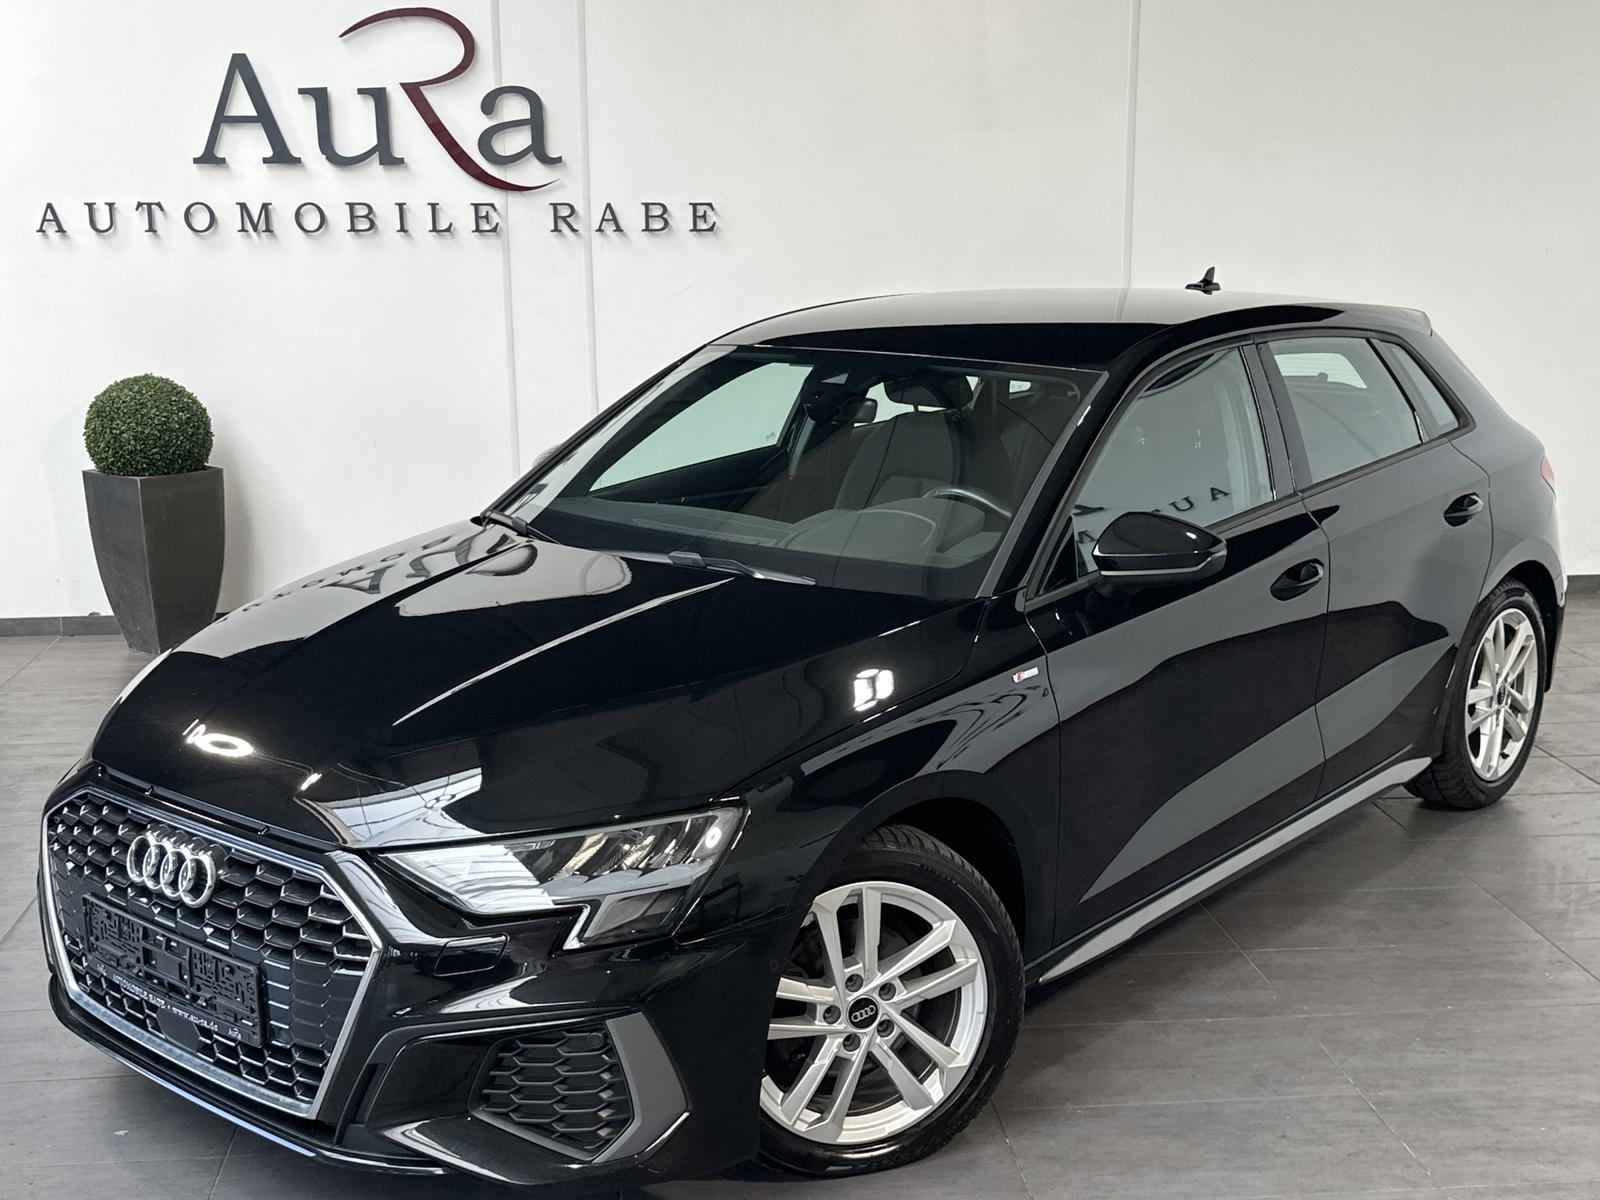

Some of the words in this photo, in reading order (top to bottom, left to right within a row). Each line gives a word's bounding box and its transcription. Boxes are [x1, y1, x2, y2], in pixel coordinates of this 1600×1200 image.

[193, 7, 563, 192] AuRa
[36, 202, 500, 234] AUTOMOBILE
[549, 202, 717, 234] RABE
